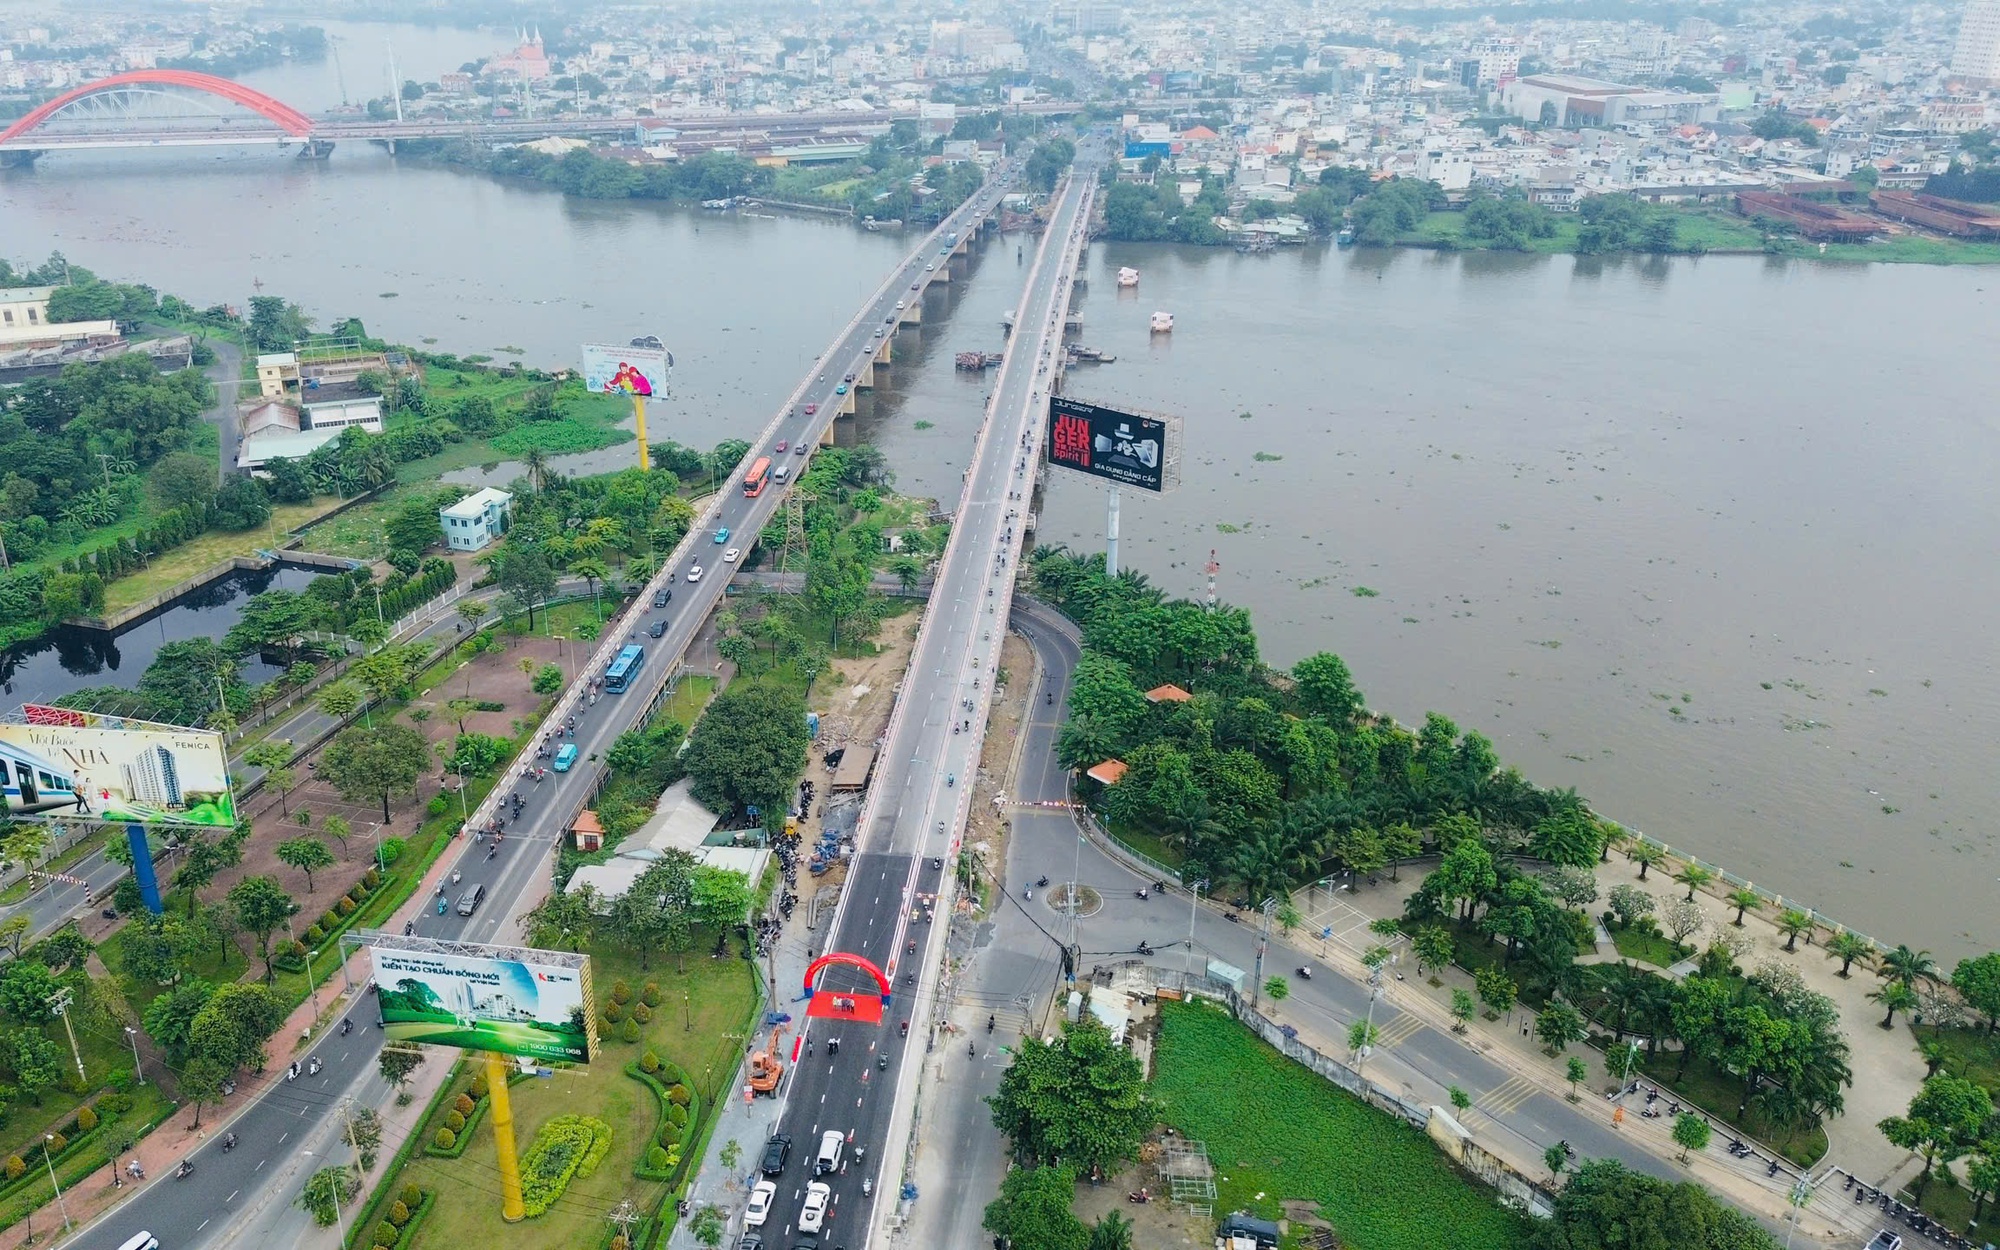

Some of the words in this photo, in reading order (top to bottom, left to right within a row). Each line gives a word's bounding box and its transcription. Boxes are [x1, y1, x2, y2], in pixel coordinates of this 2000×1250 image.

[175, 741, 210, 750] FENICA
[62, 746, 110, 771] NHÀ
[381, 962, 402, 971] KIẾN
[404, 965, 421, 973] TẠO
[422, 966, 454, 976] CHUẨN
[482, 972, 500, 981] MỚI
[529, 1043, 548, 1051] 1900
